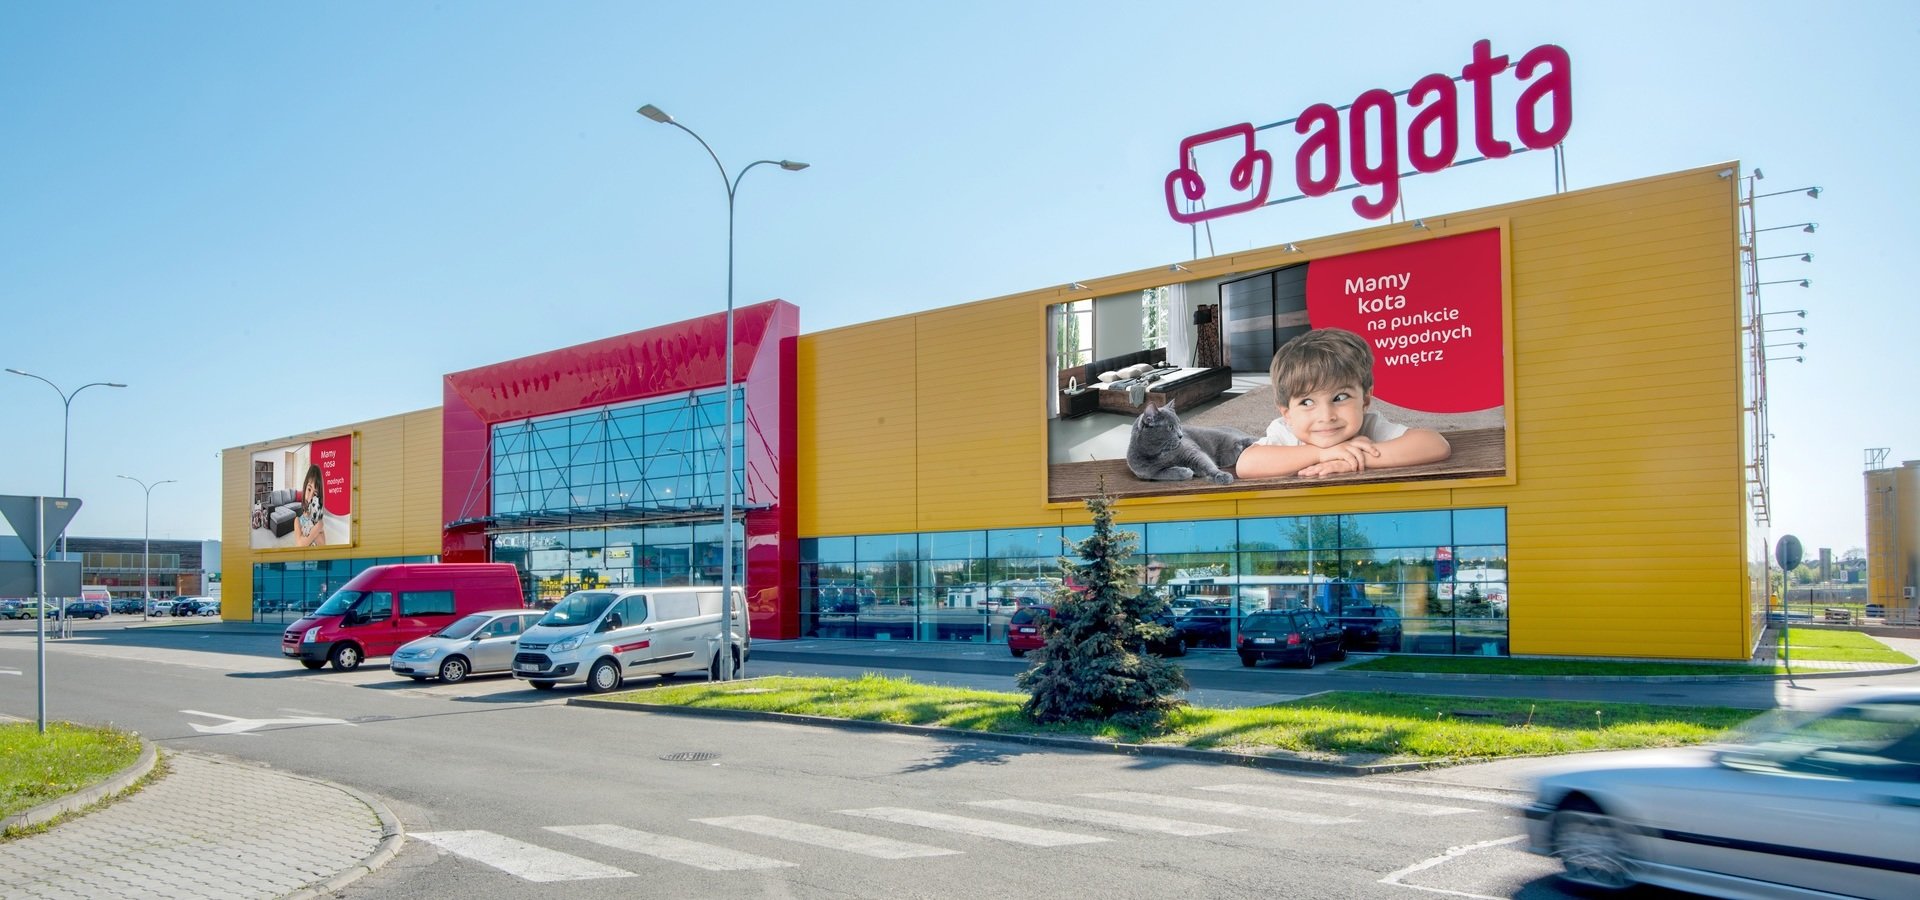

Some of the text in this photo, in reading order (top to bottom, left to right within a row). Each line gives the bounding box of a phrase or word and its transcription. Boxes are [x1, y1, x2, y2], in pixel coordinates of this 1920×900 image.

[1295, 39, 1573, 220] agata
[1344, 272, 1411, 295] Mamy
[1357, 294, 1406, 315] kota
[1367, 307, 1460, 331] na punkcie
[1374, 324, 1473, 350] wygodnych
[1384, 349, 1444, 367] wnętrz
[320, 450, 336, 459] Mamy
[323, 460, 335, 468] nosa
